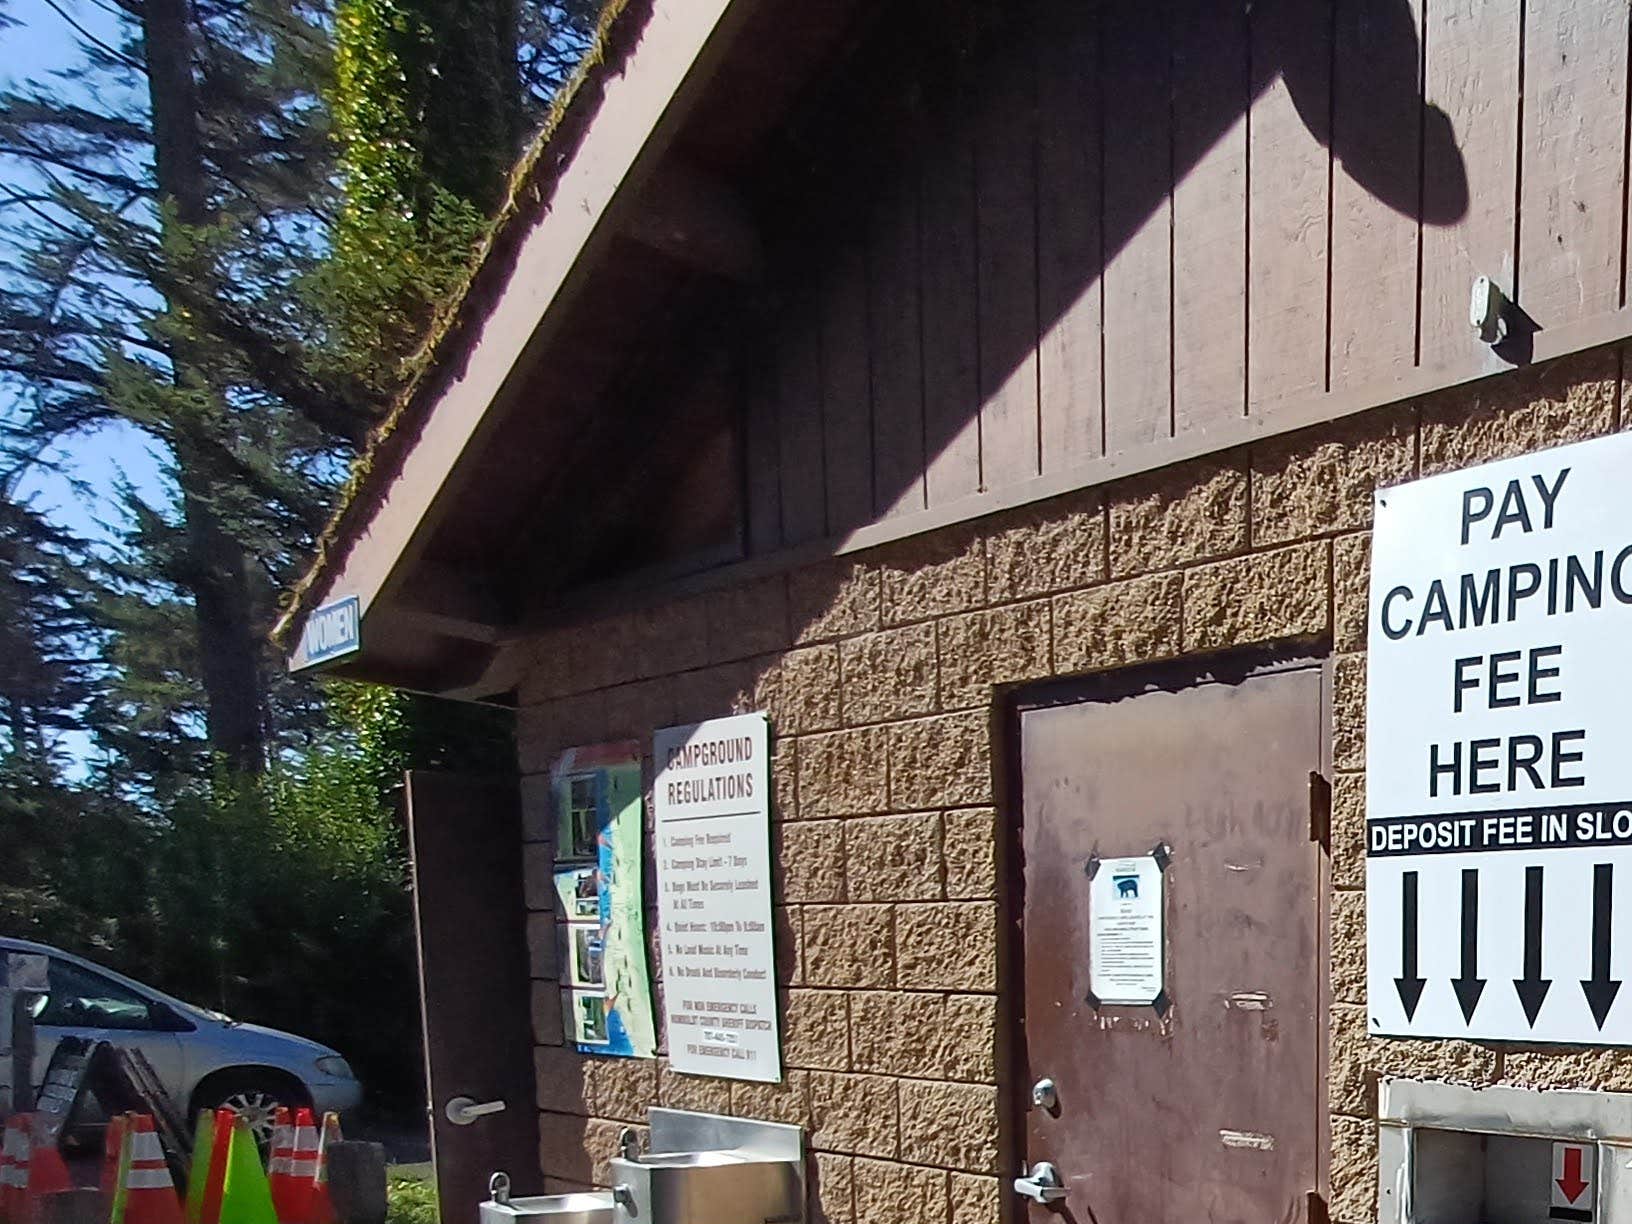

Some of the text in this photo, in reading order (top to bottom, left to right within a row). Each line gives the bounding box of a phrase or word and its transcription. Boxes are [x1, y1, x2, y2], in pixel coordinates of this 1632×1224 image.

[1460, 467, 1571, 545] PAY
[1453, 645, 1563, 713] FEE
[668, 737, 752, 771] CAMPGROUND
[1429, 730, 1586, 797] HERE
[668, 773, 753, 805] REGULATIONS
[1371, 819, 1475, 850] DEPOSIT
[1482, 815, 1533, 845] FEE
[1541, 814, 1567, 842] IN
